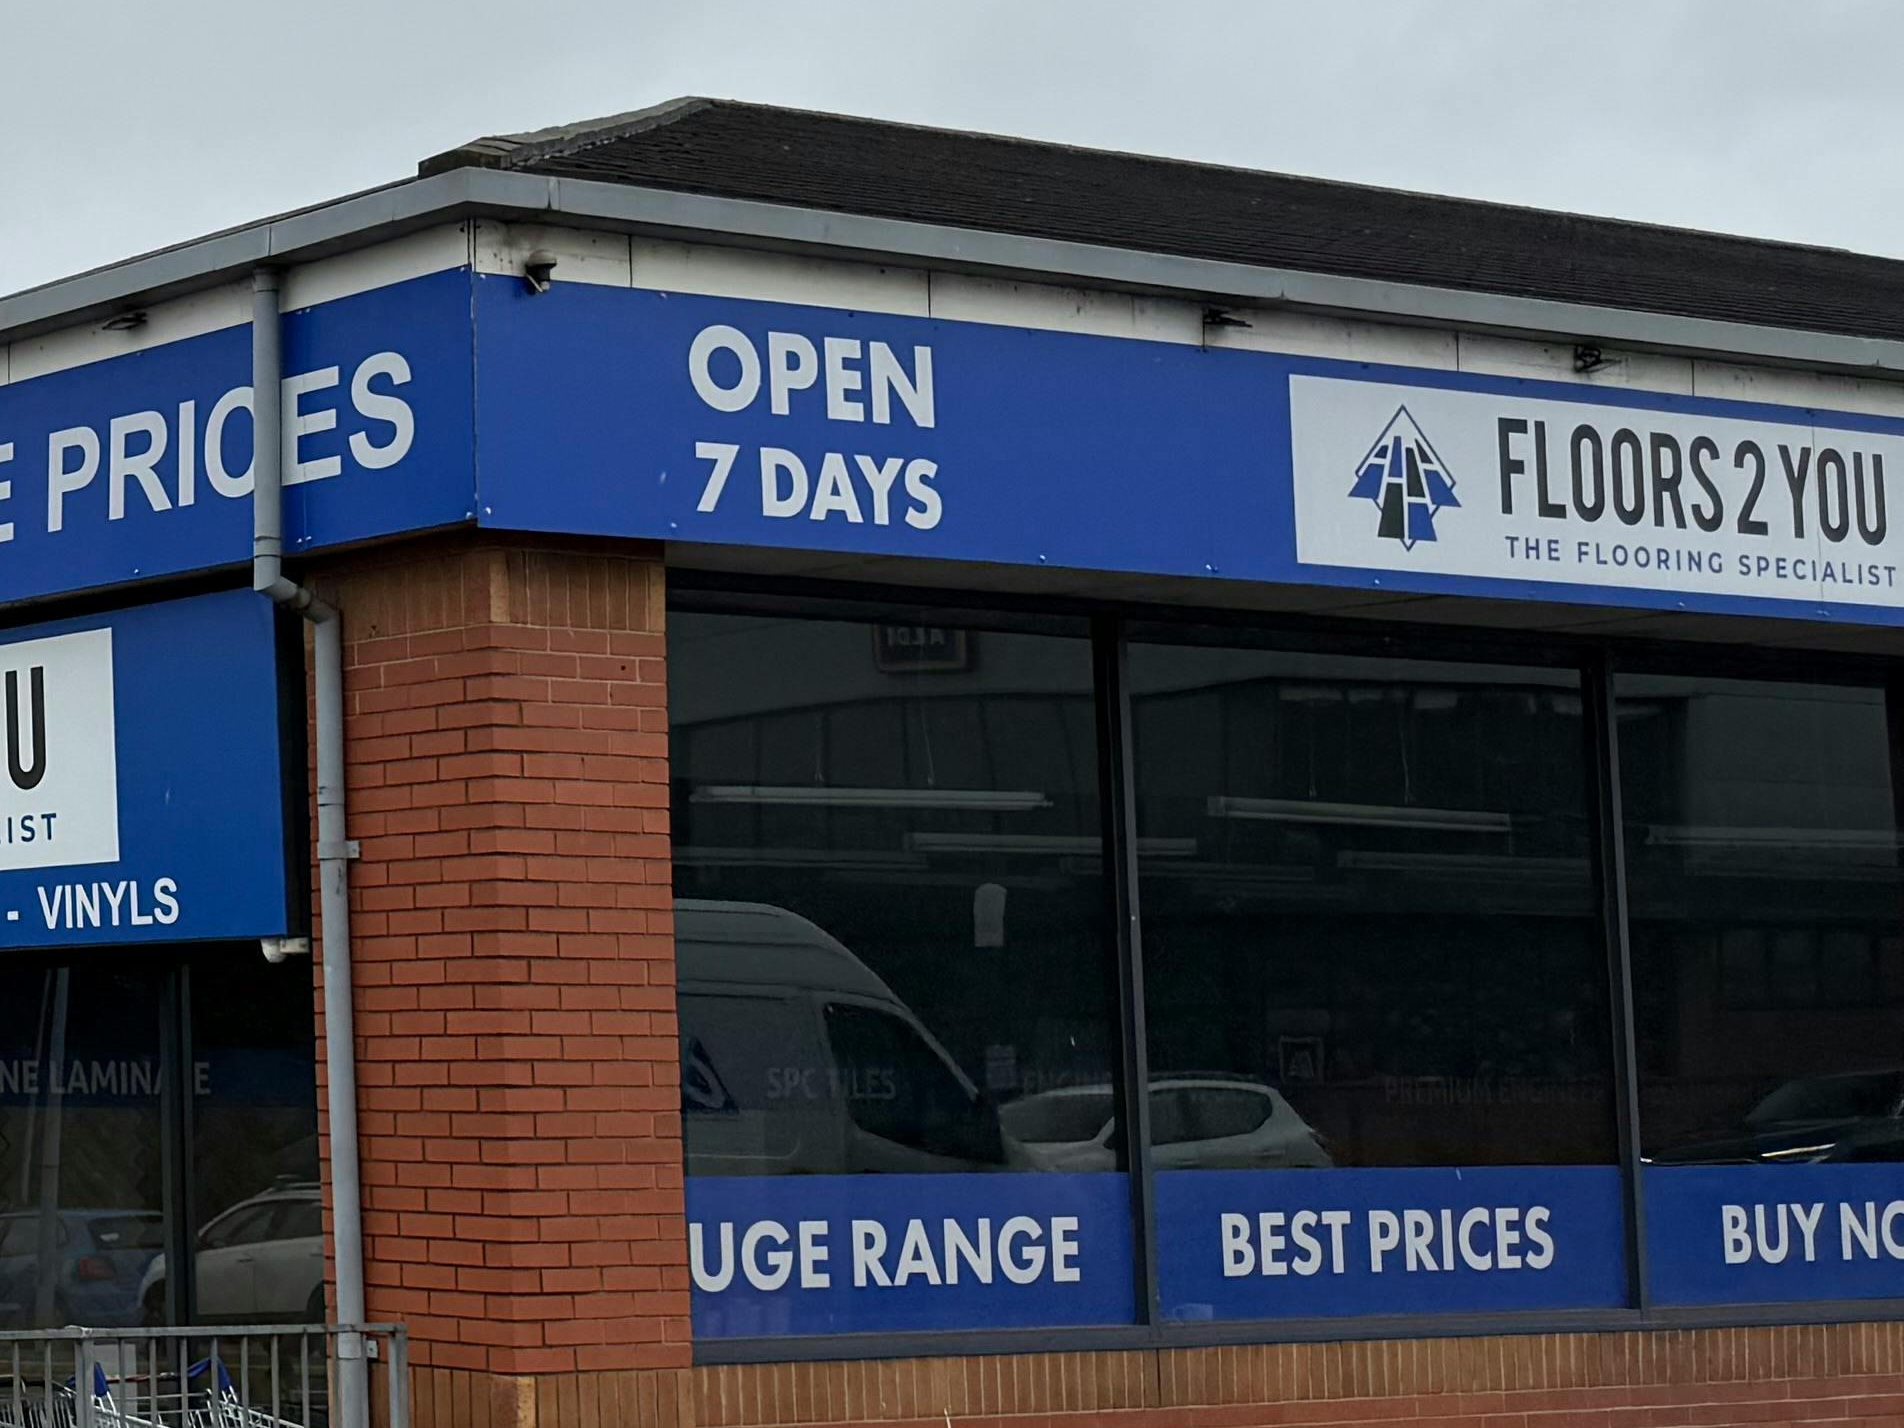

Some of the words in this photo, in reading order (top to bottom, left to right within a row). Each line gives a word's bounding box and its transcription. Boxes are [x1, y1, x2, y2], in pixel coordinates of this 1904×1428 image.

[688, 324, 935, 429] OPEN
[47, 352, 414, 533] PRICES
[695, 441, 740, 513] 7
[759, 446, 943, 530] DAYS
[1504, 535, 1561, 561] THE
[1577, 541, 1723, 573] FLOORING
[1739, 554, 1897, 587] SPECIALIST
[37, 877, 180, 930] VINYLS
[48, 1059, 211, 1096] LAMINE
[688, 1219, 830, 1293] UGE
[851, 1215, 1081, 1288] RANGE
[1220, 1210, 1351, 1277] BEST
[1368, 1205, 1555, 1273] PRICES
[1721, 1202, 1825, 1265] BUY
[1839, 1199, 1904, 1261] NO
